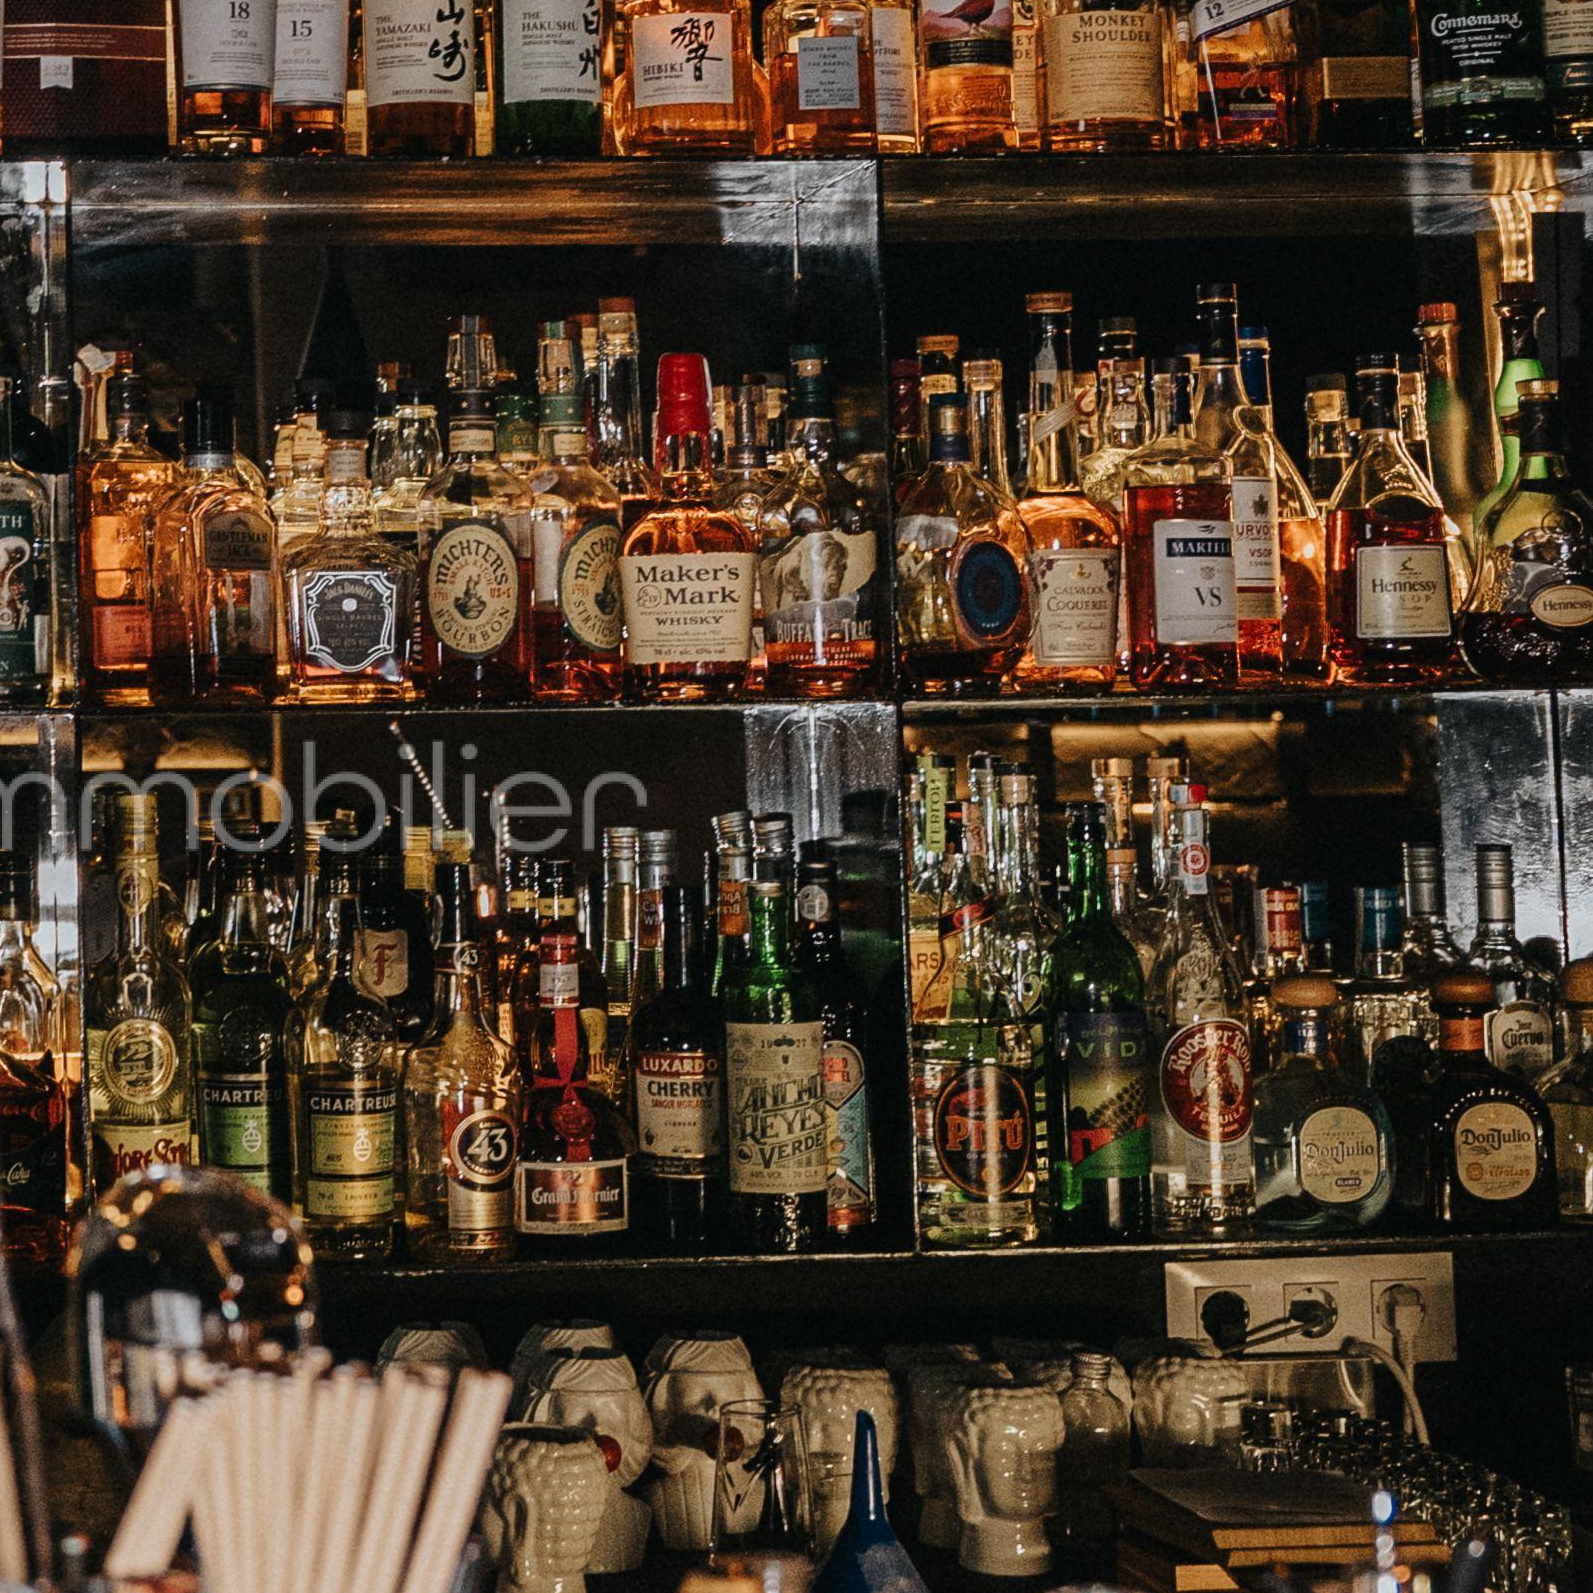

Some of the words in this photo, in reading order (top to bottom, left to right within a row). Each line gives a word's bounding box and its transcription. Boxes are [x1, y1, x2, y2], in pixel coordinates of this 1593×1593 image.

[228, 1, 251, 20] 18
[522, 11, 541, 21] THE
[1204, 3, 1225, 20] 12
[290, 20, 313, 38] 15
[375, 16, 393, 25] THE
[375, 22, 432, 37] YAMAZAKI
[521, 20, 580, 33] HAKUSHU
[1079, 14, 1146, 29] MONKEY
[1431, 11, 1523, 37] Connemara
[1494, 32, 1513, 42] MALT
[671, 17, 724, 82] 響
[642, 63, 684, 77] HIBIKI
[1459, 57, 1496, 67] ORIGINAL
[209, 530, 269, 544] GENTLEMAN
[634, 563, 741, 584] Maker's
[664, 586, 740, 606] Mark
[1371, 578, 1439, 596] Hennessy
[1194, 585, 1223, 608] VS
[1542, 598, 1593, 615] Hennessy
[655, 615, 725, 627] WHISKY
[776, 620, 828, 644] BUFFAO
[461, 950, 479, 966] 43
[1501, 1026, 1544, 1050] Cuervo
[1167, 1028, 1232, 1074] Rooster
[642, 1057, 719, 1074] LUXARDO
[646, 1079, 717, 1098] CHERRY
[739, 1074, 823, 1115] ANCHO
[740, 1100, 829, 1146] REYES
[466, 1119, 508, 1163] 43
[757, 1131, 823, 1170] VERDE
